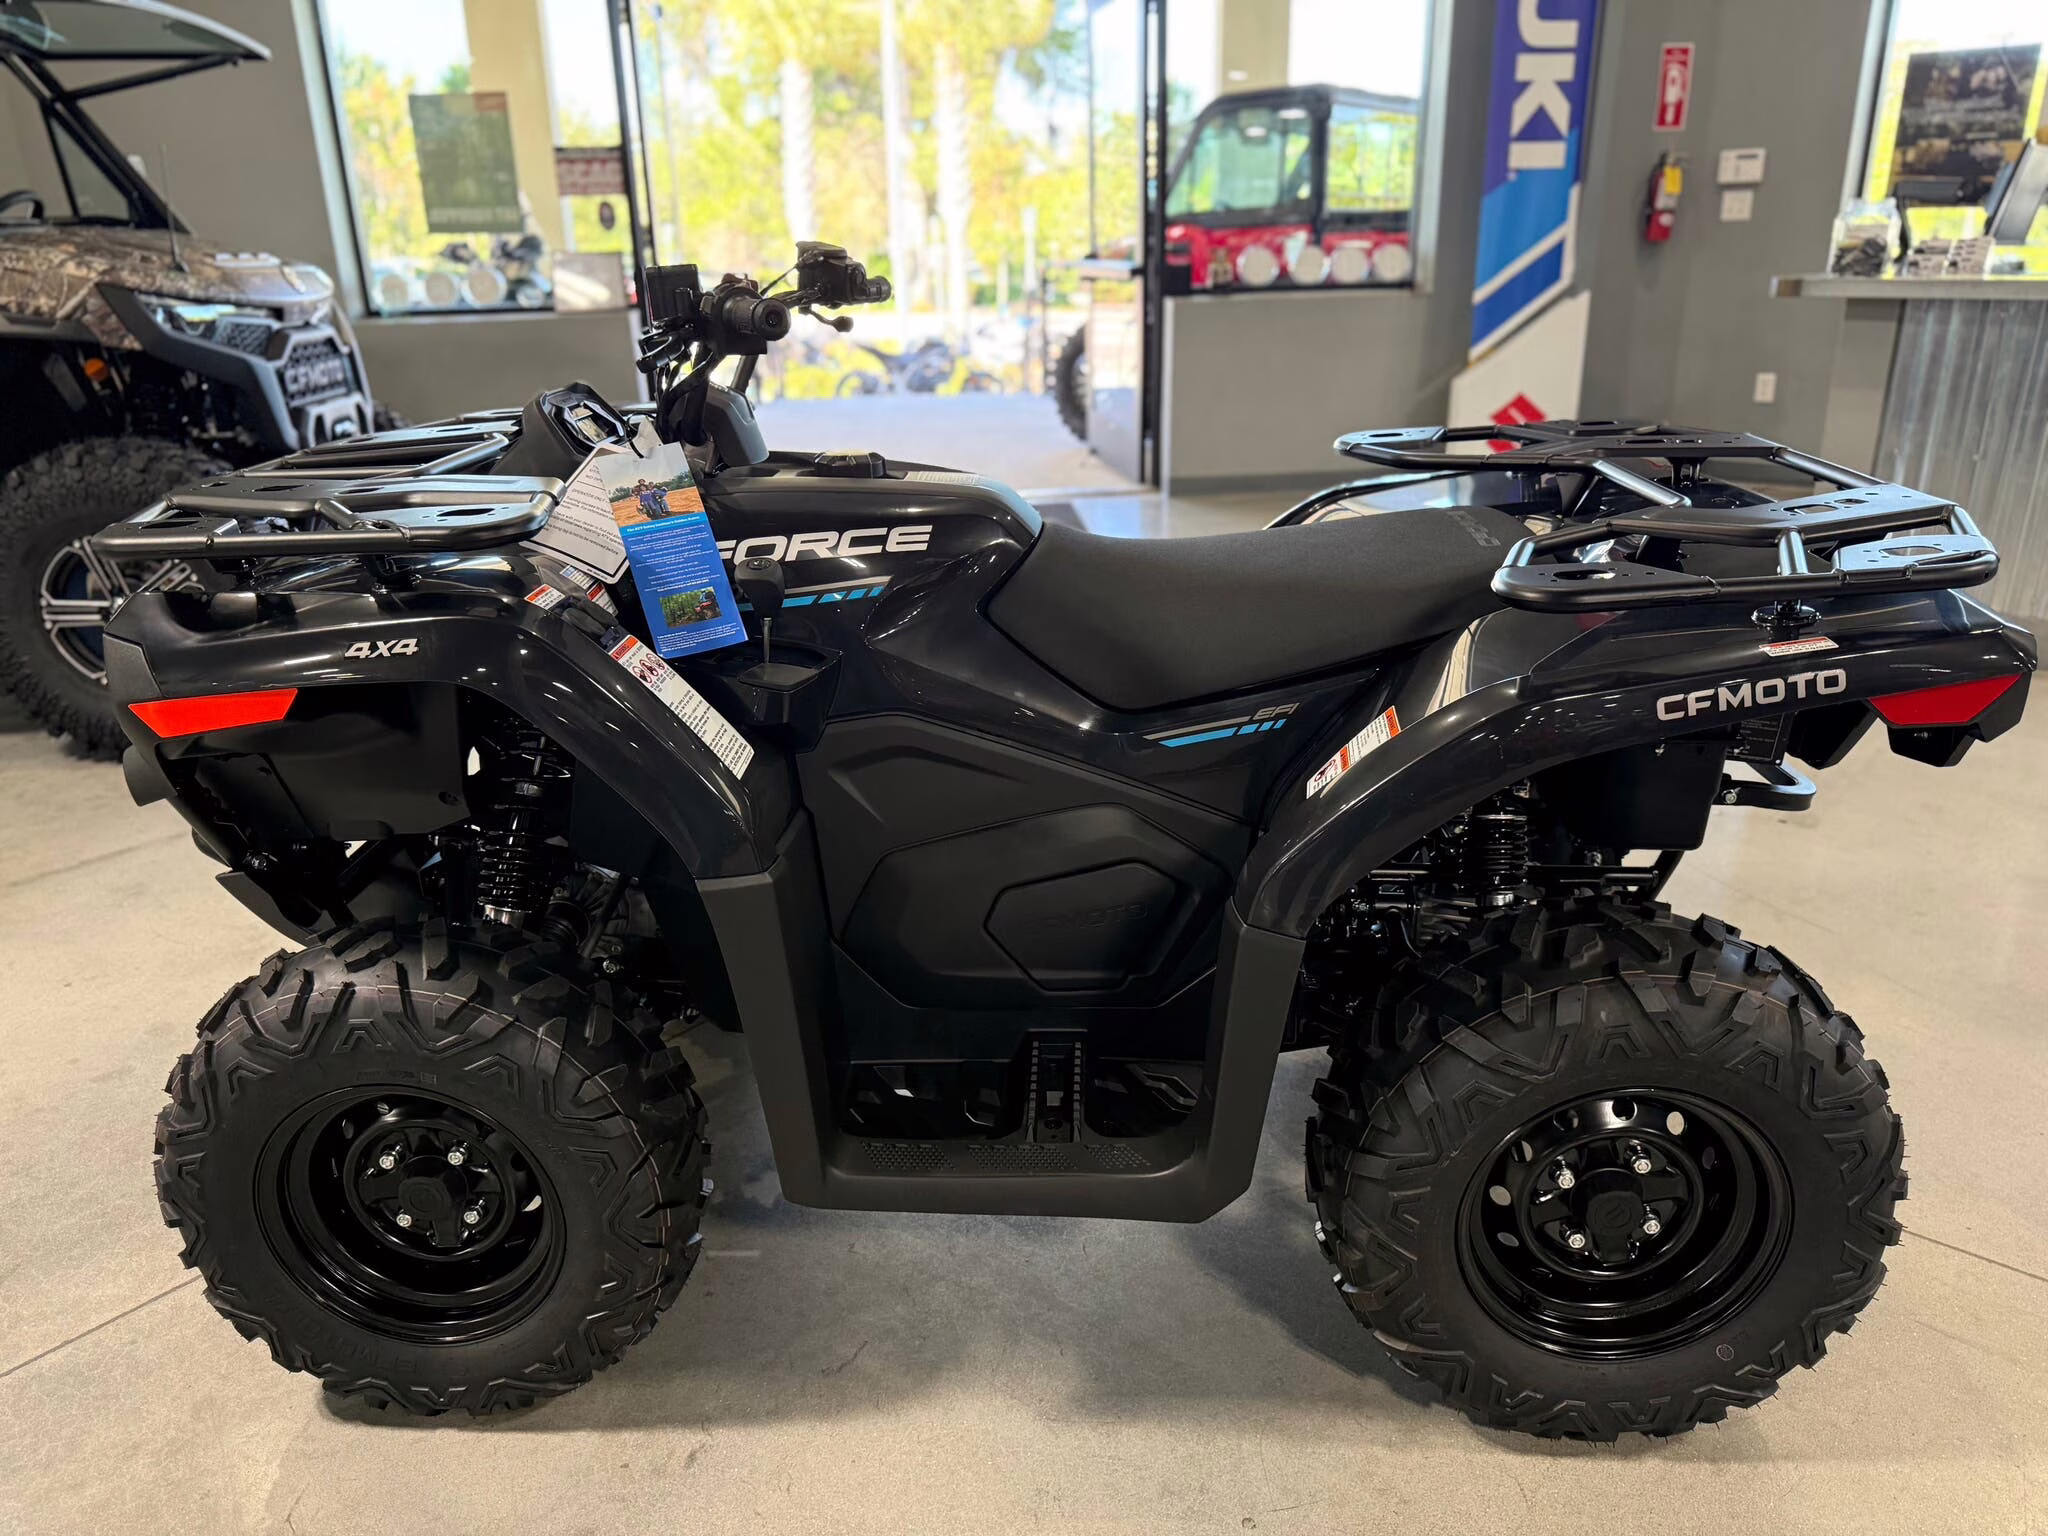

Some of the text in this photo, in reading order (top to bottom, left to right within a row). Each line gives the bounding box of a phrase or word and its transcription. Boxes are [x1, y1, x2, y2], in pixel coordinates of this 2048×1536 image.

[344, 638, 419, 659] 4X4
[1656, 668, 1847, 721] CFMOTO
[1252, 702, 1300, 720] EFI
